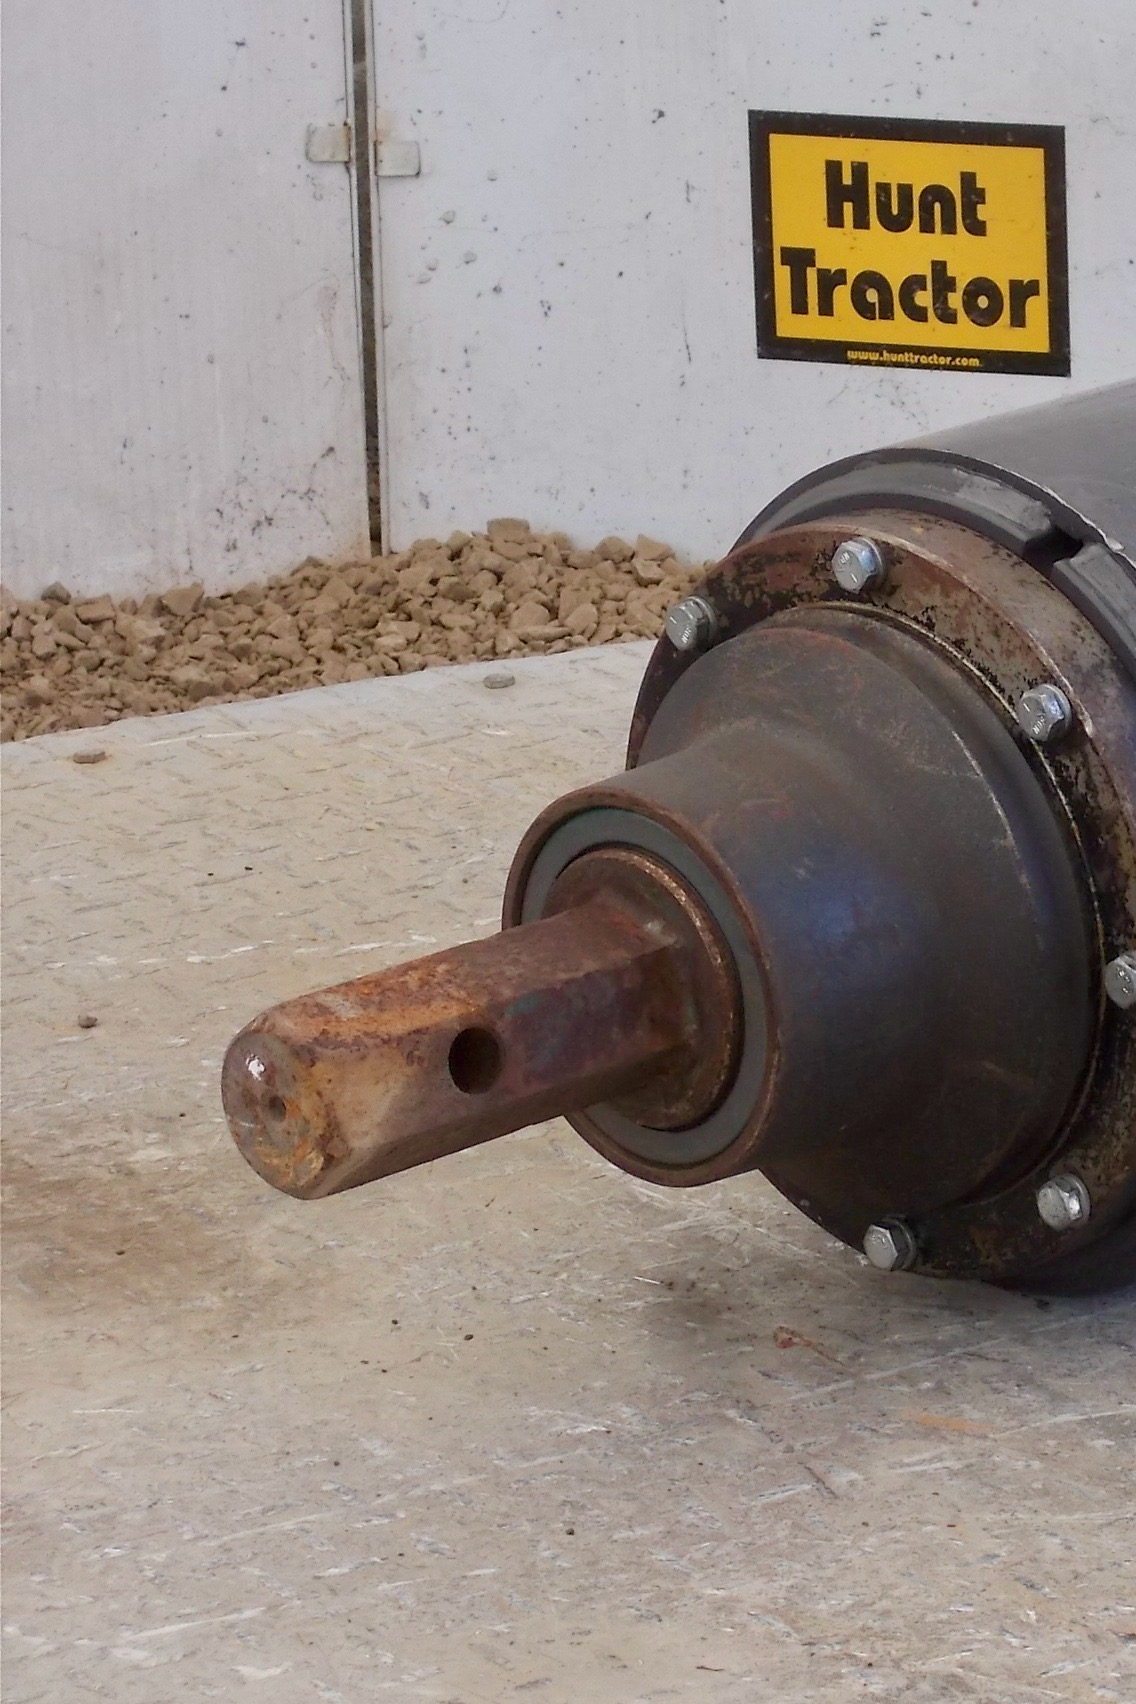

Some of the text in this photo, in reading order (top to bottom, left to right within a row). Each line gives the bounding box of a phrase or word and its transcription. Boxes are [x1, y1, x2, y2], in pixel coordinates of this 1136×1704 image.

[825, 159, 987, 237] Hunt
[780, 246, 1040, 328] Tractor
[847, 350, 981, 367] www.hunttractor.com
